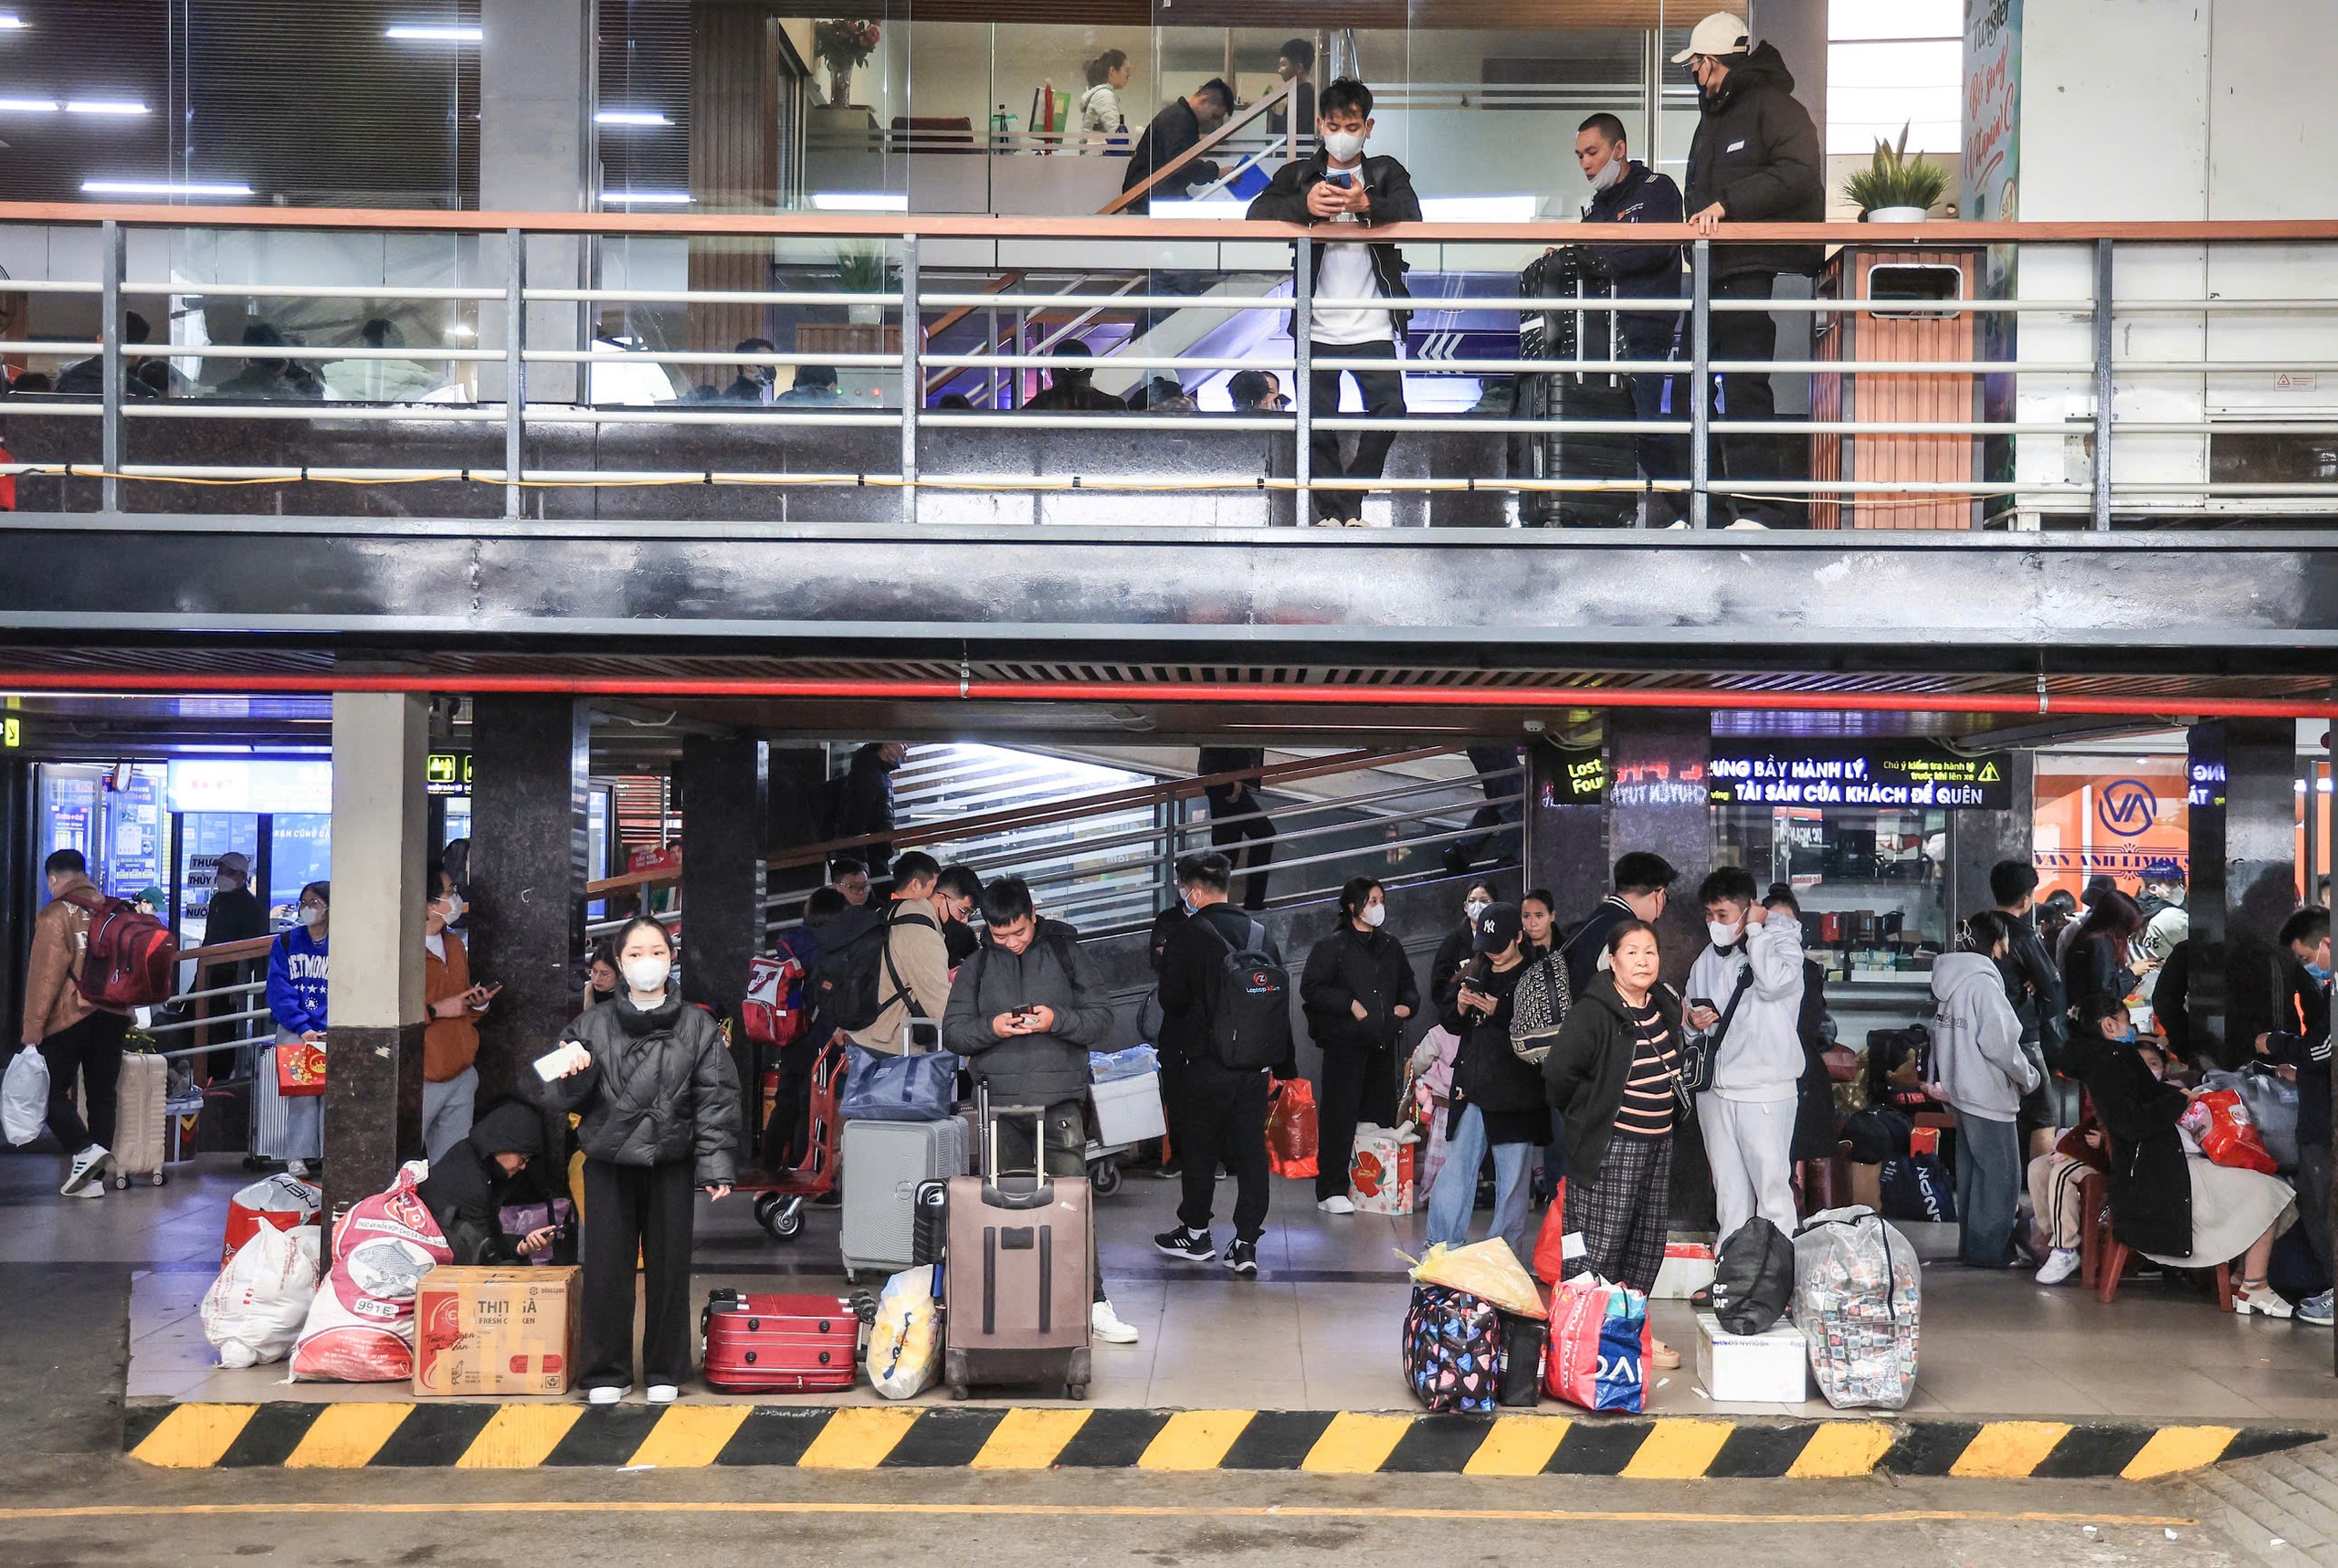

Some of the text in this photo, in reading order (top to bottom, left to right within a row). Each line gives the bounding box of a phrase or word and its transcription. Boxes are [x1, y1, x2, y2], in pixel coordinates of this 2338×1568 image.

[1567, 759, 1603, 778] Lost
[1791, 757, 1841, 778] HÀNH
[1845, 758, 1868, 781] LÝ,
[1883, 761, 1899, 769] Chú
[1908, 759, 1928, 771] kiểm
[1930, 762, 1943, 771] tra
[1943, 762, 1964, 771] hành
[1965, 762, 1975, 773] lý
[1934, 772, 1947, 780] khi
[1949, 772, 1962, 781] lên
[1735, 779, 1983, 804] TÀI SẢN CỦA KHÁCH ĐỂ QUÊN
[2078, 855, 2115, 867] ANH
[1483, 919, 1496, 934] NY
[357, 1300, 393, 1316] 991E
[478, 1298, 537, 1316] THỊT À
